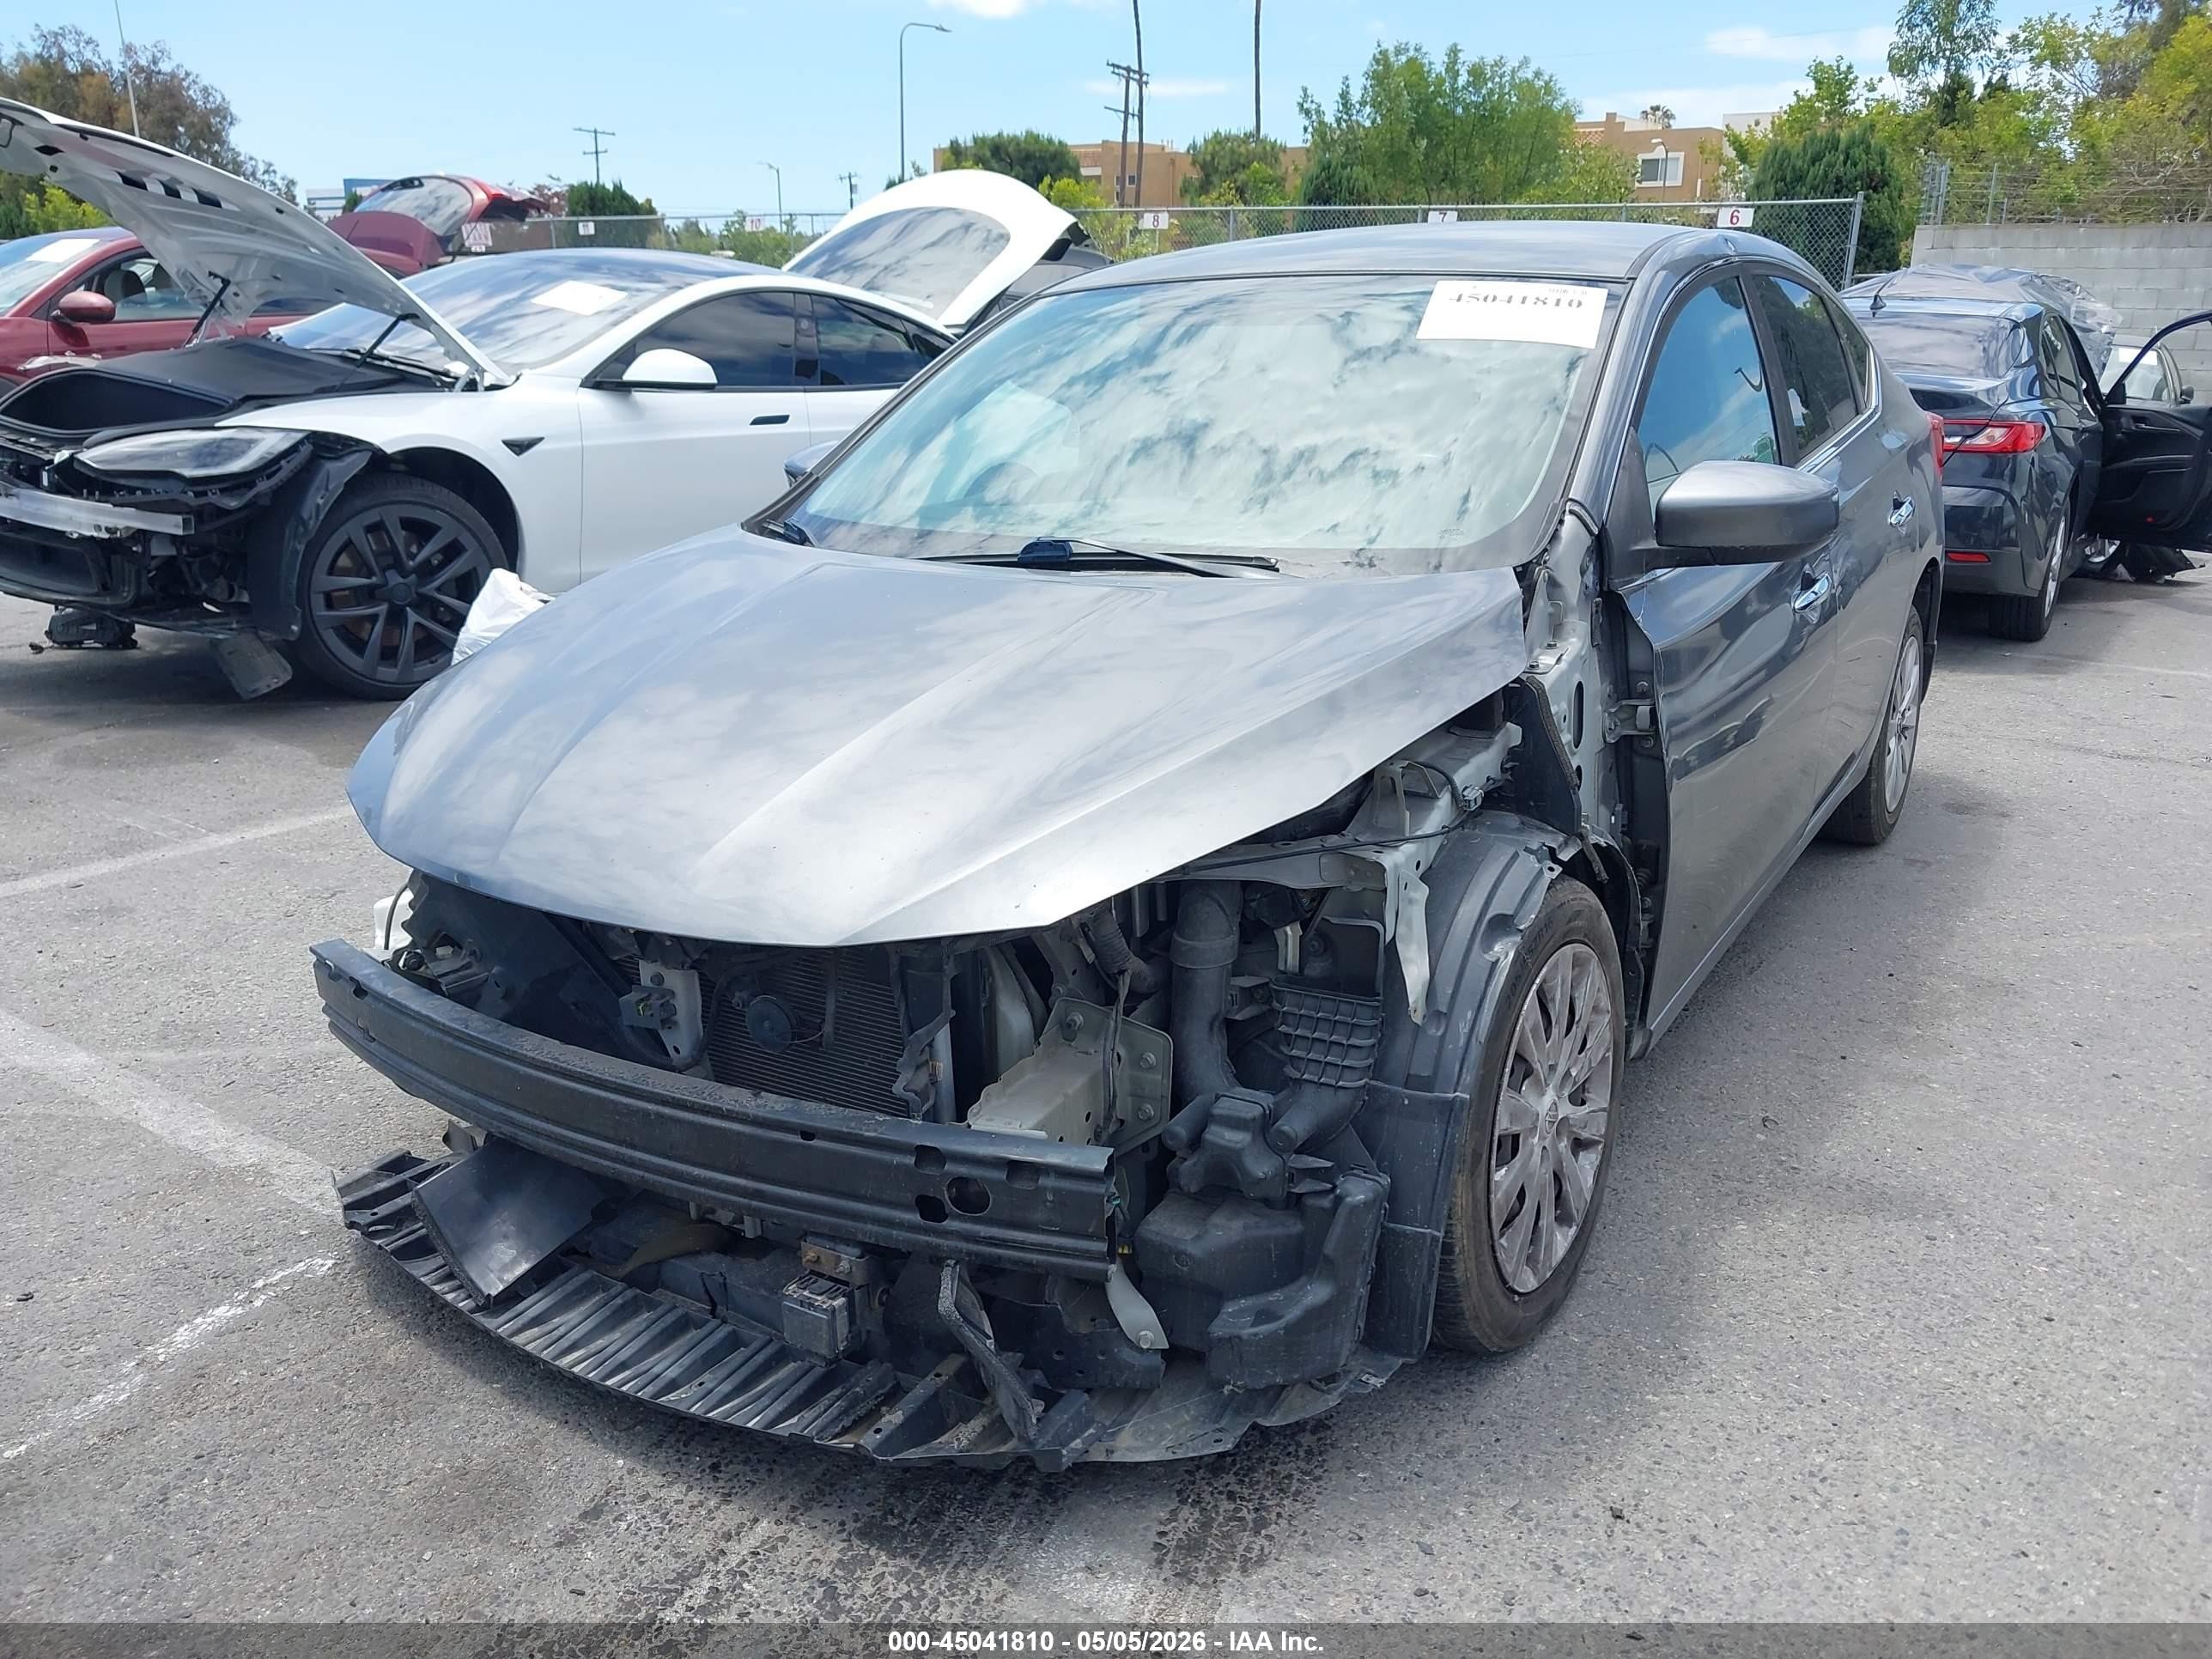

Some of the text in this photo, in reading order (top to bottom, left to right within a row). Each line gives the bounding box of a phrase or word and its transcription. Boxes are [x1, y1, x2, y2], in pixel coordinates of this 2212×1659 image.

[1152, 214, 1160, 228] 8
[1438, 211, 1448, 223] 7
[1729, 209, 1741, 226] 6
[750, 218, 762, 230] 10
